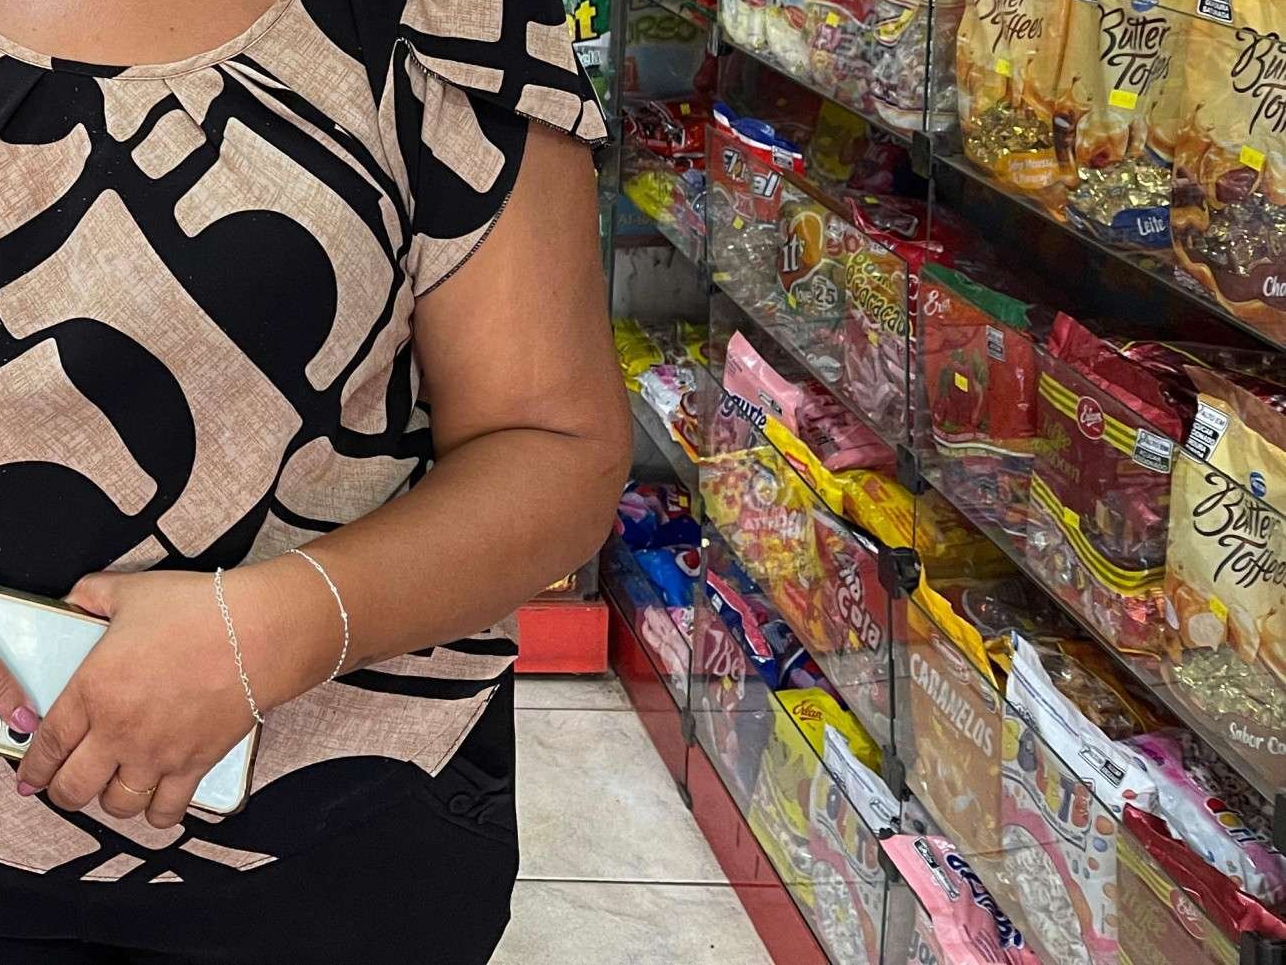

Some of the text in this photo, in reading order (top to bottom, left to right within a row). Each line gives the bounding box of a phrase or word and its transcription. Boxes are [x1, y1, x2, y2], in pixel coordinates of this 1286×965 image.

[1098, 4, 1172, 62] Butter
[1137, 215, 1164, 237] Leite
[1192, 472, 1279, 538] Butter
[835, 585, 883, 652] Cola
[909, 652, 995, 757] CARAMELOS
[1229, 721, 1265, 752] Sabor
